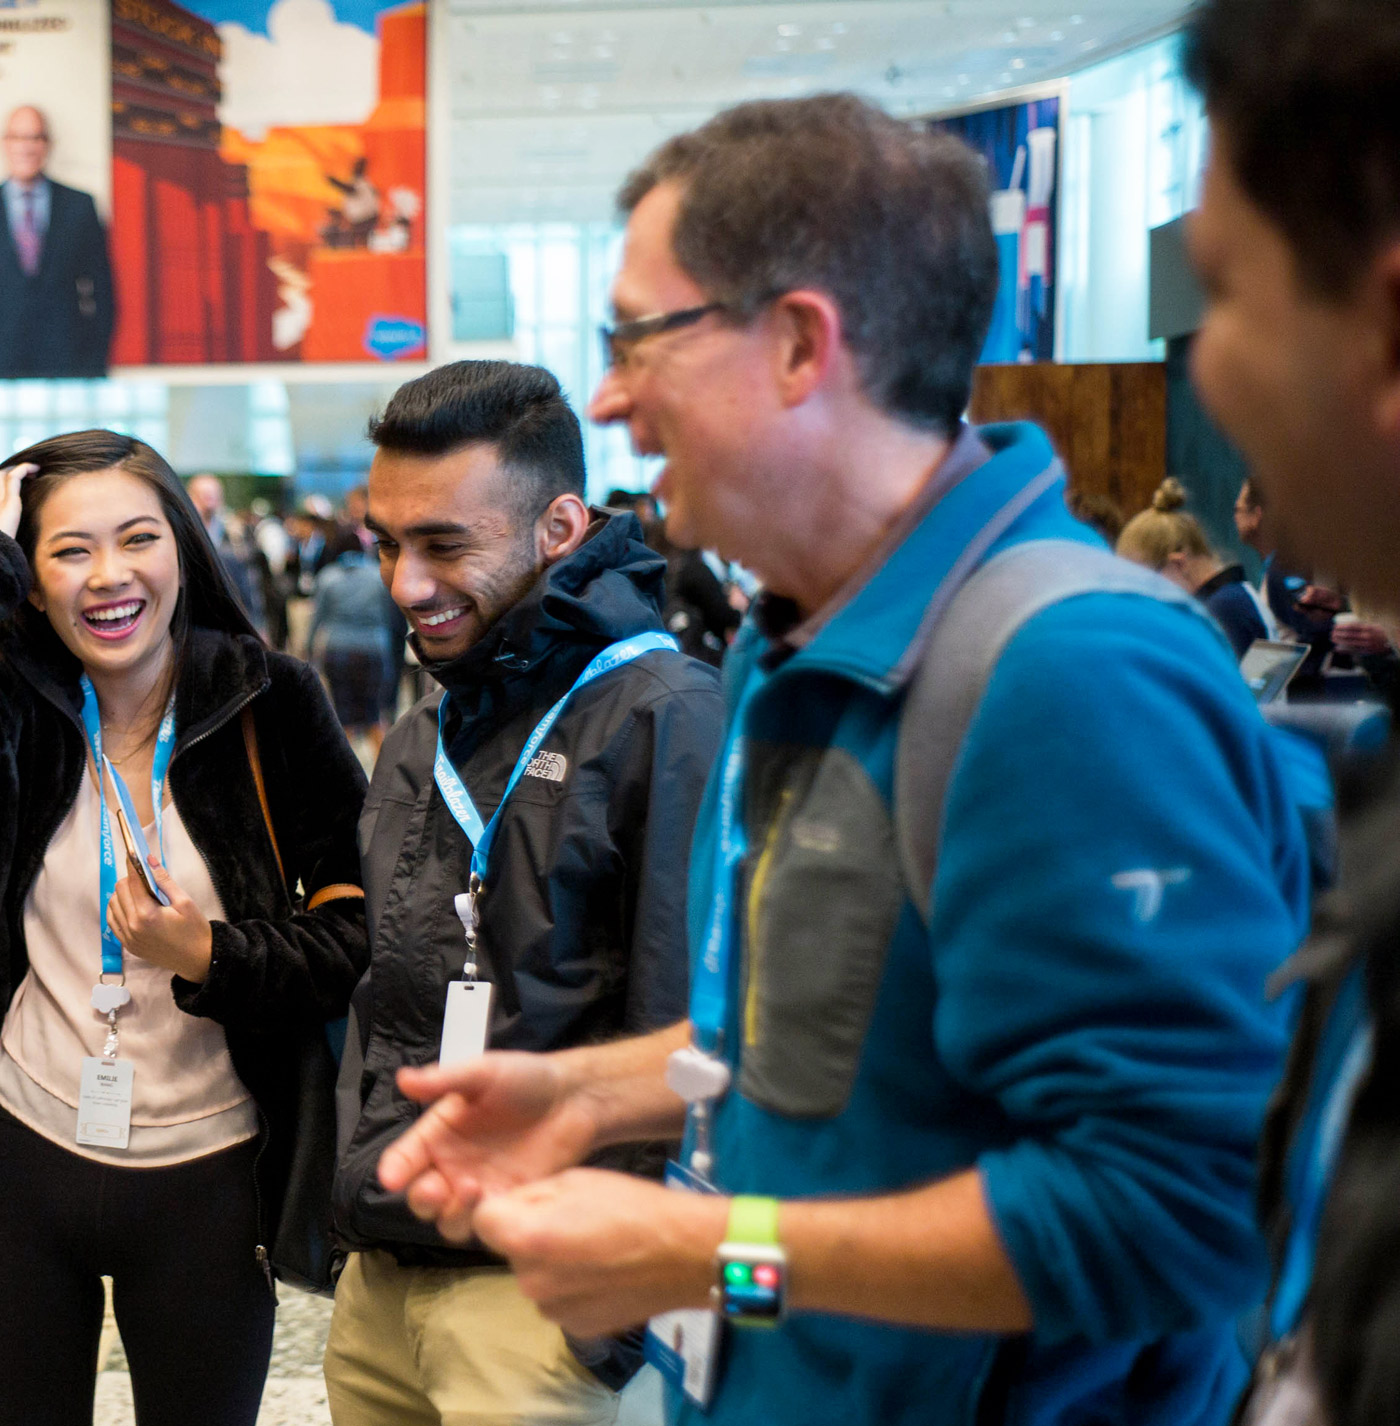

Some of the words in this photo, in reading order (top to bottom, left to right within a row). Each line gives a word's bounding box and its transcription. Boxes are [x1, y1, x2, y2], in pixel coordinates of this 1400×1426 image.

[538, 750, 557, 761] THE
[526, 757, 552, 771] ORTH
[524, 766, 550, 779] FACE
[435, 753, 472, 823] Trailblazer
